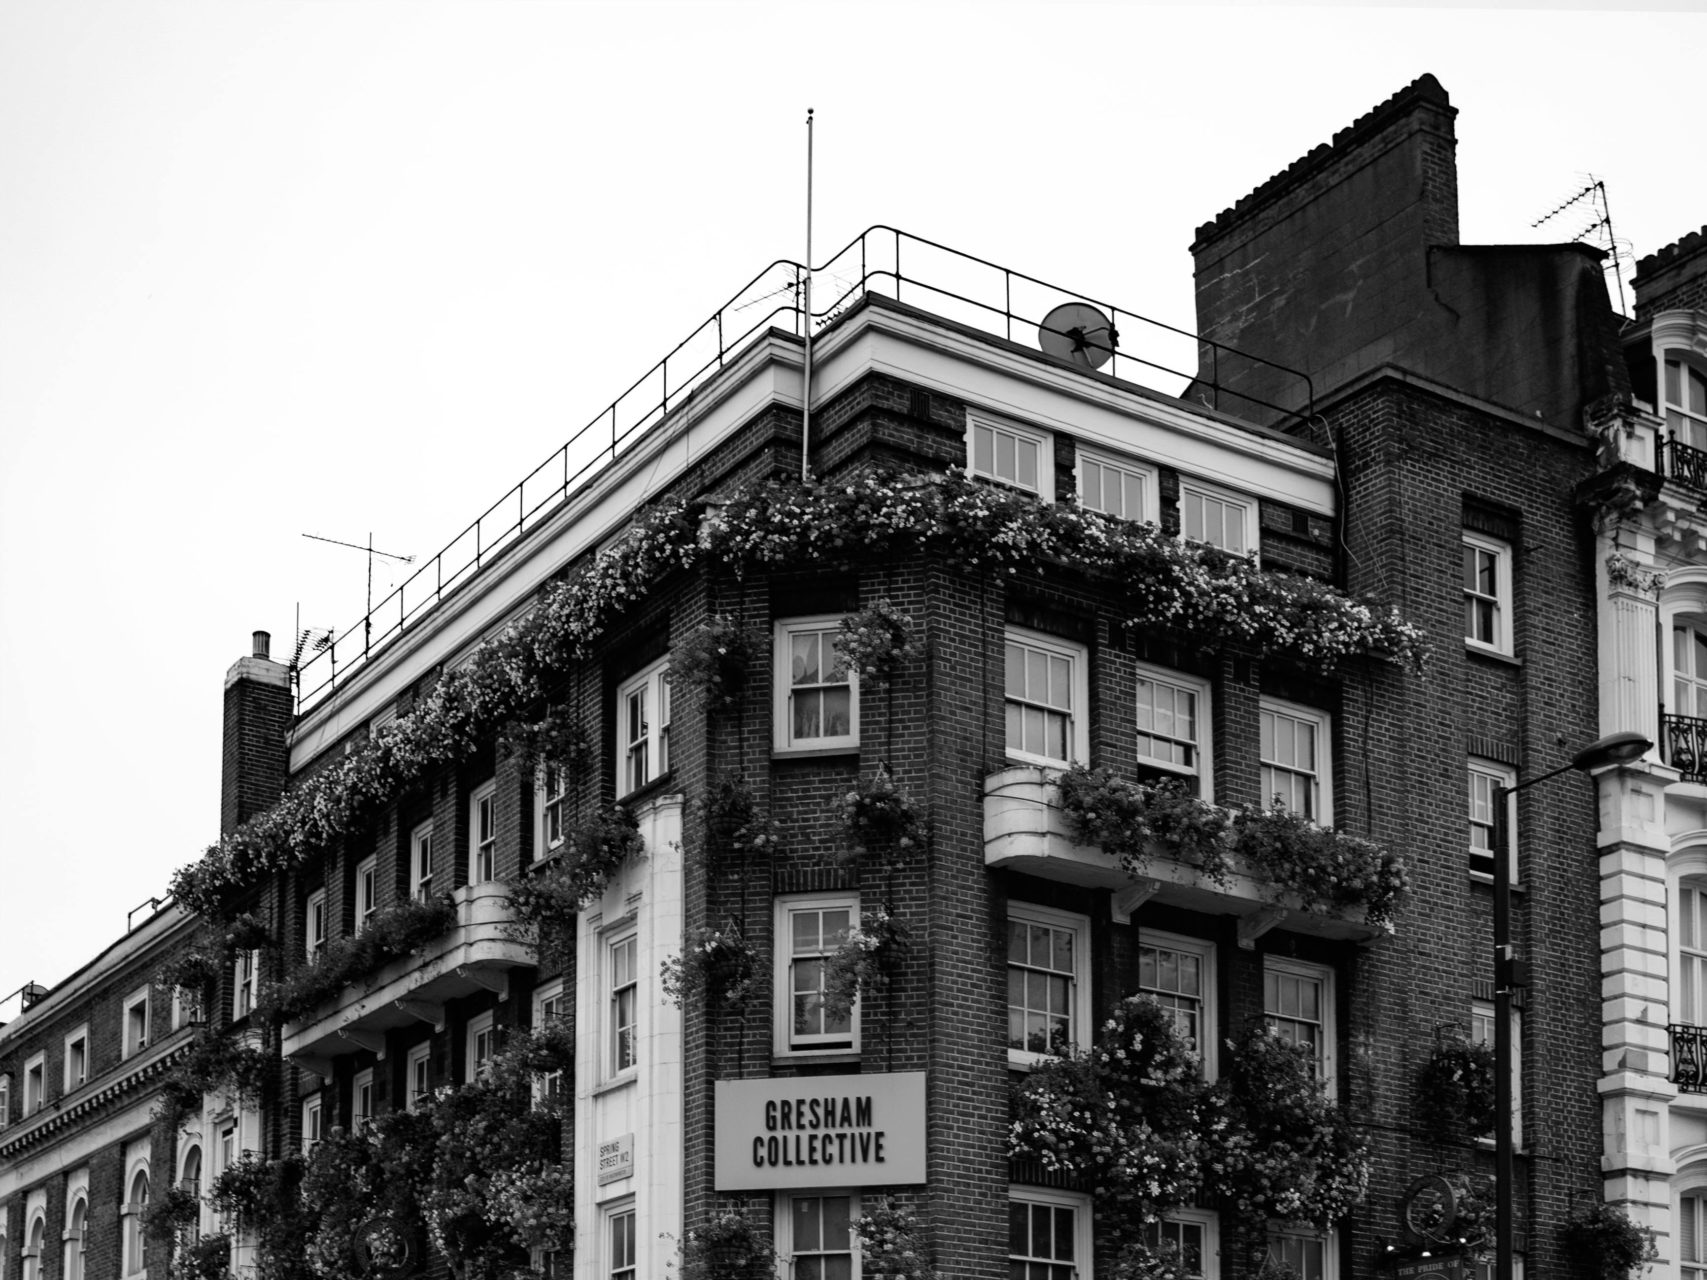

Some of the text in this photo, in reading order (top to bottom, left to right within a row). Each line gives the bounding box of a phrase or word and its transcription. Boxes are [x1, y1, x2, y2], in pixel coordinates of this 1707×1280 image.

[765, 1096, 872, 1131] GRESHAM
[600, 1154, 619, 1170] STREET
[753, 1131, 886, 1168] COLLECTIVE
[1398, 1259, 1460, 1276] THE PRIDE OF
